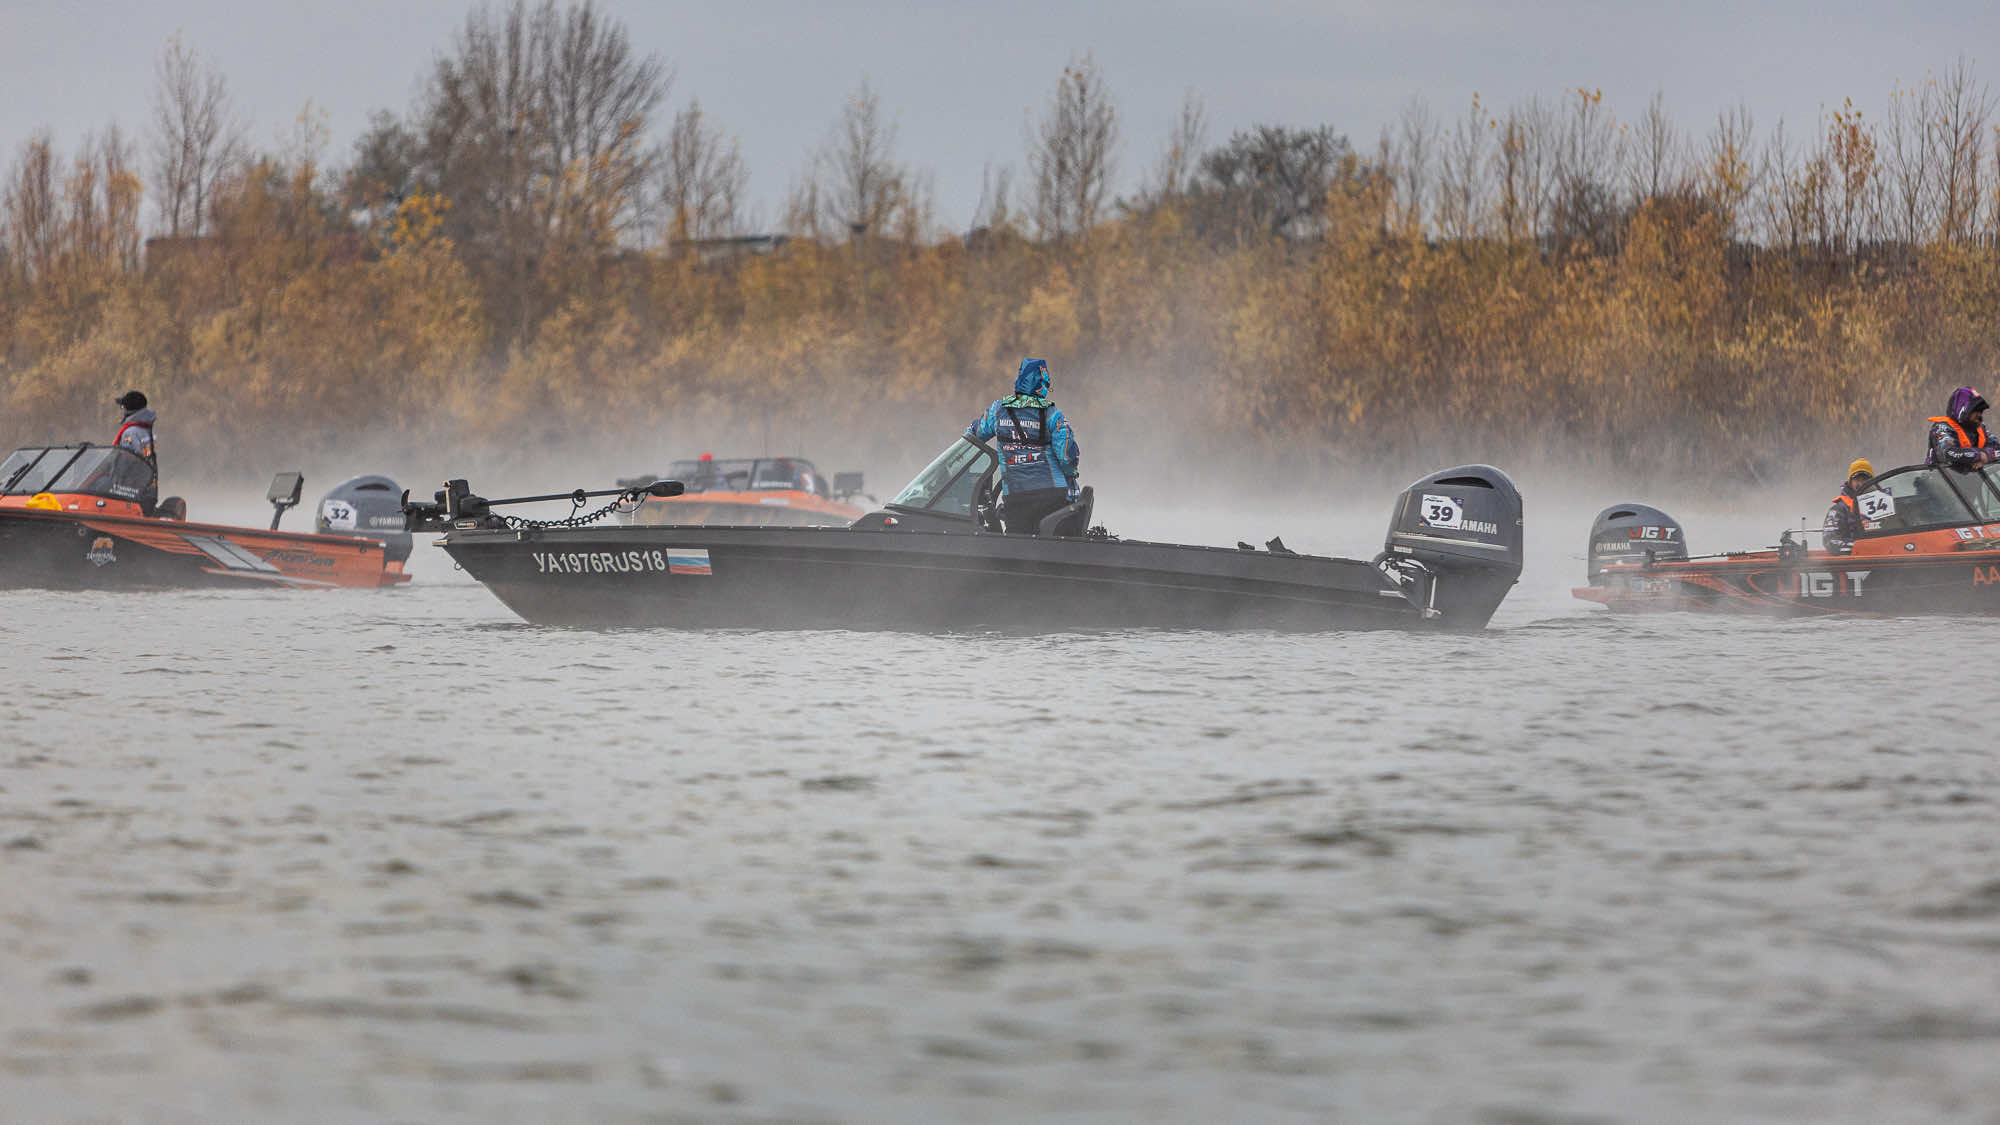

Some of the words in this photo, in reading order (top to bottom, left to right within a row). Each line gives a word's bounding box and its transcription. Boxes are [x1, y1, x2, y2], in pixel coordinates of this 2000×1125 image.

[331, 507, 350, 521] 32
[1429, 505, 1454, 522] 39
[1865, 497, 1888, 516] 34
[1601, 542, 1632, 553] YAMAHA
